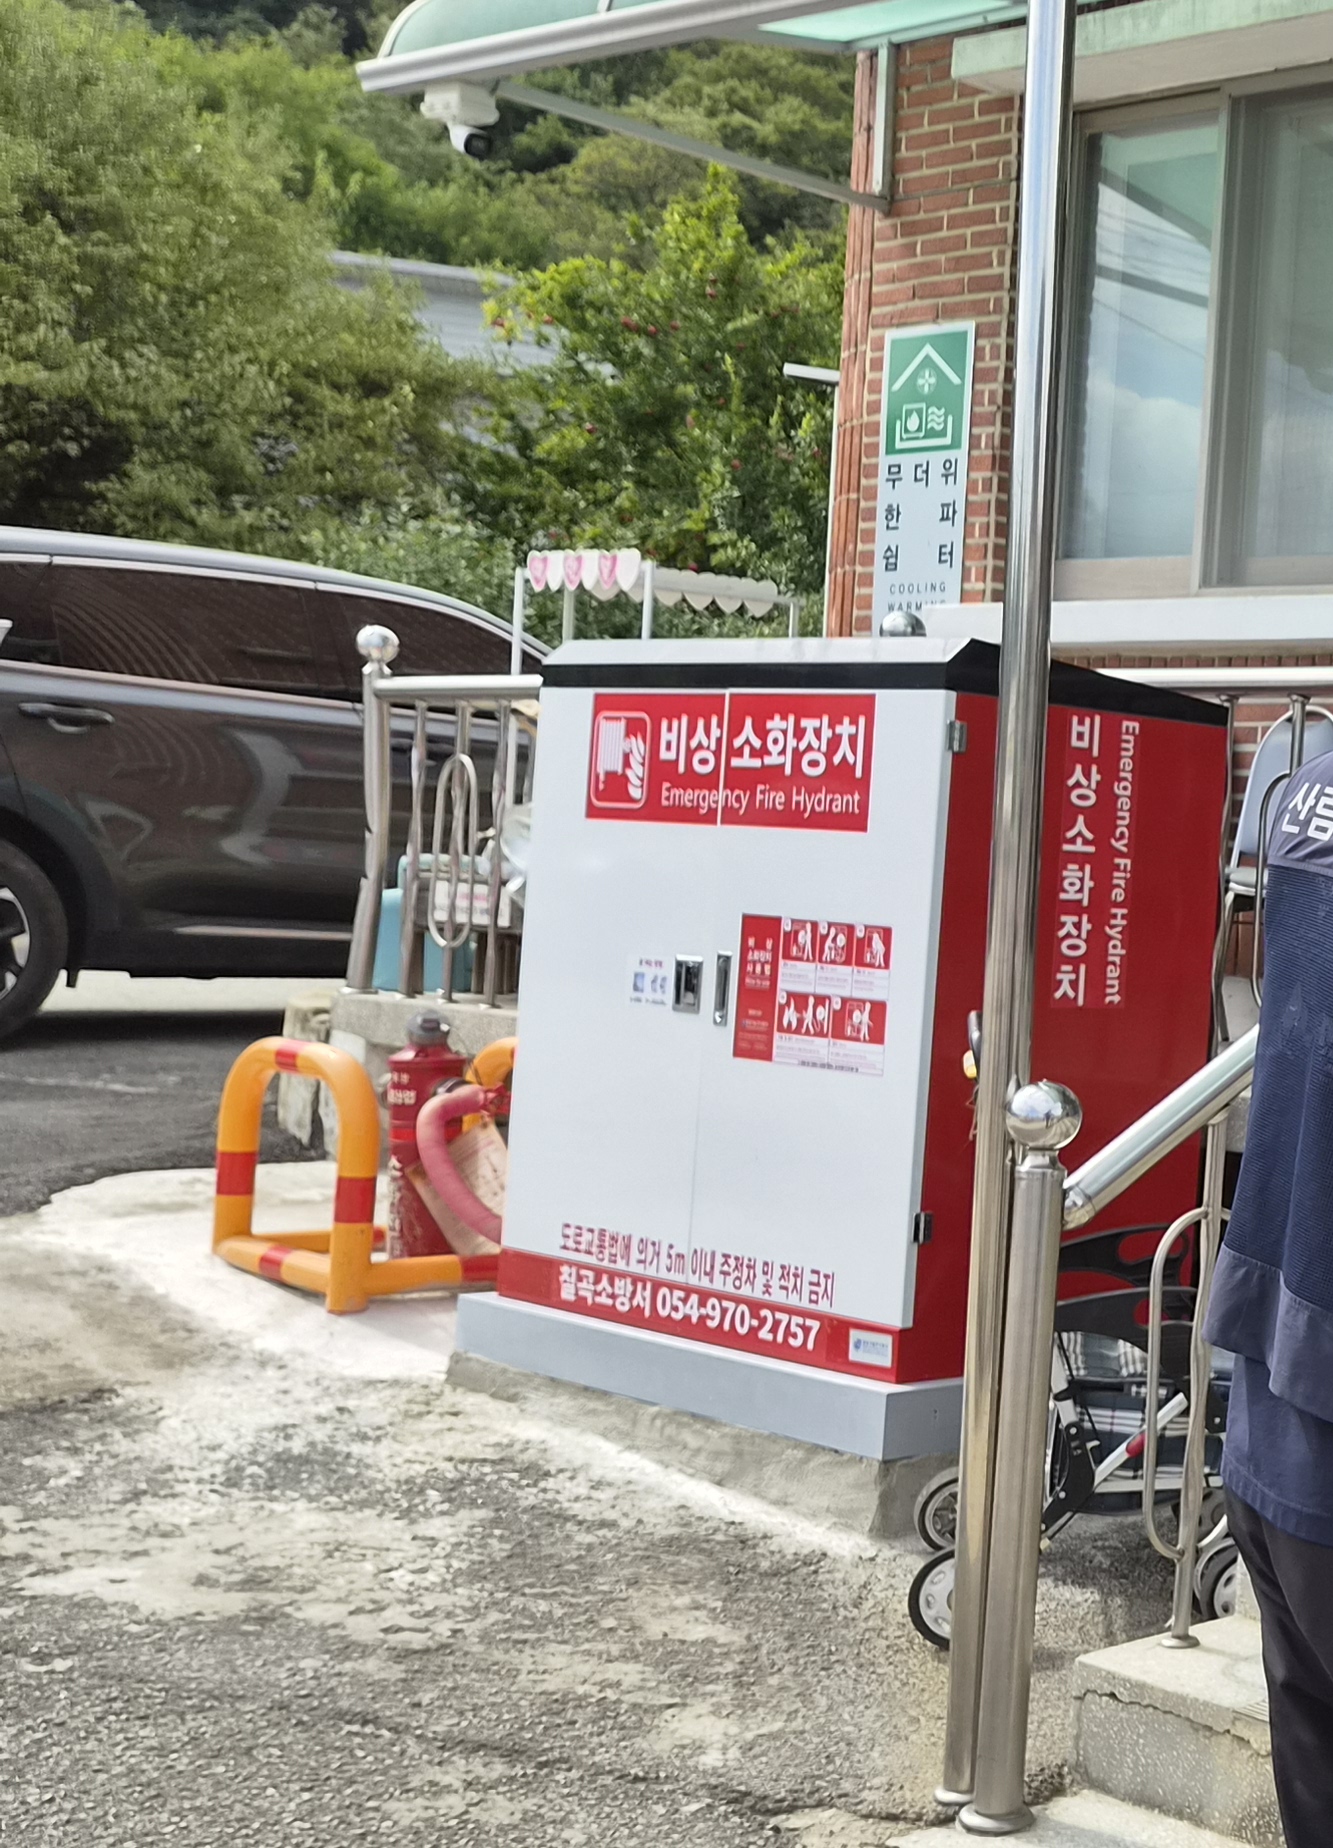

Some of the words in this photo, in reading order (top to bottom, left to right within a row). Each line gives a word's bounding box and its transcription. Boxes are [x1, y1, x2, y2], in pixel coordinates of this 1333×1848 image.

[885, 458, 958, 490] 무더위
[888, 599, 946, 612] WARM
[890, 581, 946, 595] COOLING
[659, 714, 721, 775] 비상
[730, 712, 866, 779] 소화장치
[661, 782, 750, 816] Emergency
[756, 784, 785, 811] Fire
[792, 785, 860, 819] Hydrant
[1110, 719, 1140, 853] Emergency
[1054, 714, 1101, 1008] 비상소화장치
[1111, 857, 1131, 902] Fire
[1104, 907, 1128, 1005] Hydrant
[560, 1222, 632, 1266] 도로교통법에
[636, 1236, 662, 1274] 의거
[665, 1243, 686, 1275] 5m
[691, 1248, 716, 1285] 이내
[719, 1251, 757, 1293] 주정차
[762, 1260, 774, 1297] 및
[778, 1260, 804, 1302] 적치
[808, 1268, 835, 1308] 금지
[559, 1263, 652, 1318] 칠곡소방서
[657, 1286, 820, 1351] 054-970-2757
